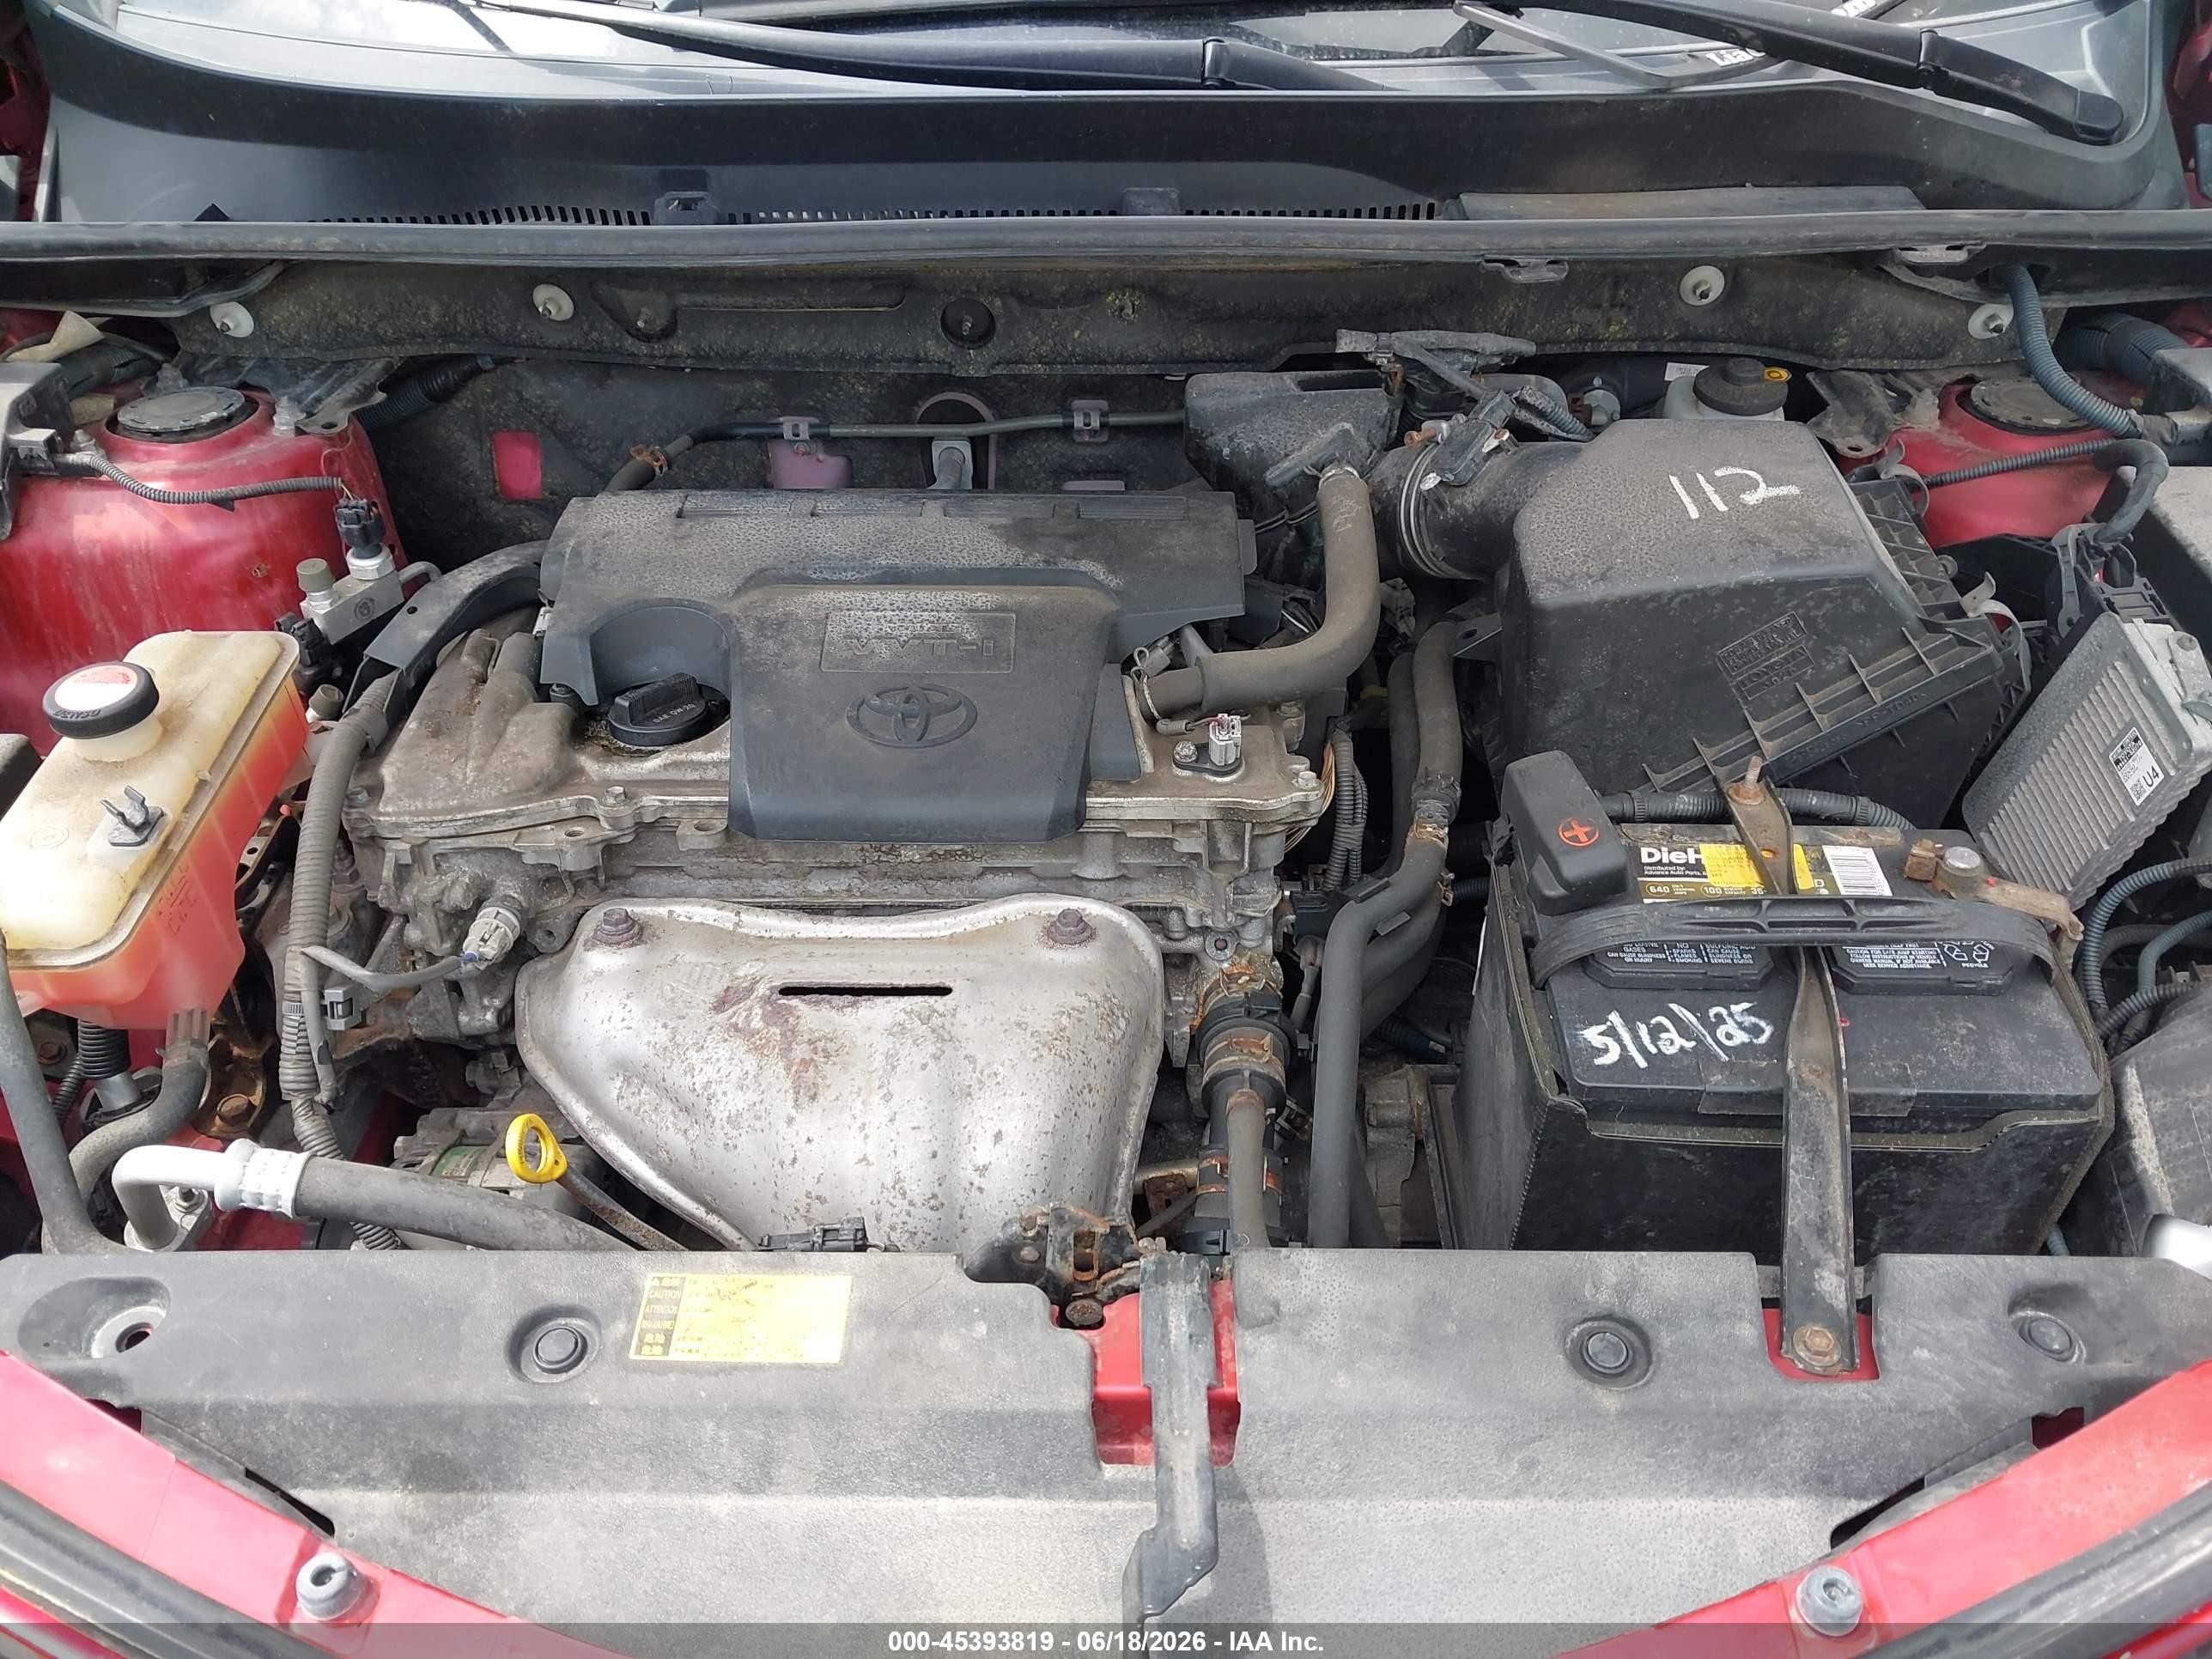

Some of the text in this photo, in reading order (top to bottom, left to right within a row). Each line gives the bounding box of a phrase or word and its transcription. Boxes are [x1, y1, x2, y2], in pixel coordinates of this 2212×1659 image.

[1668, 466, 1801, 519] 112
[53, 708, 102, 719] DENSO
[670, 702, 696, 715] 0W-20
[2142, 765, 2160, 787] U4
[1704, 886, 1723, 895] 100
[1578, 1002, 1775, 1068] 5/12/25
[648, 1289, 682, 1299] CAUTION
[645, 1304, 678, 1314] ATTENTION
